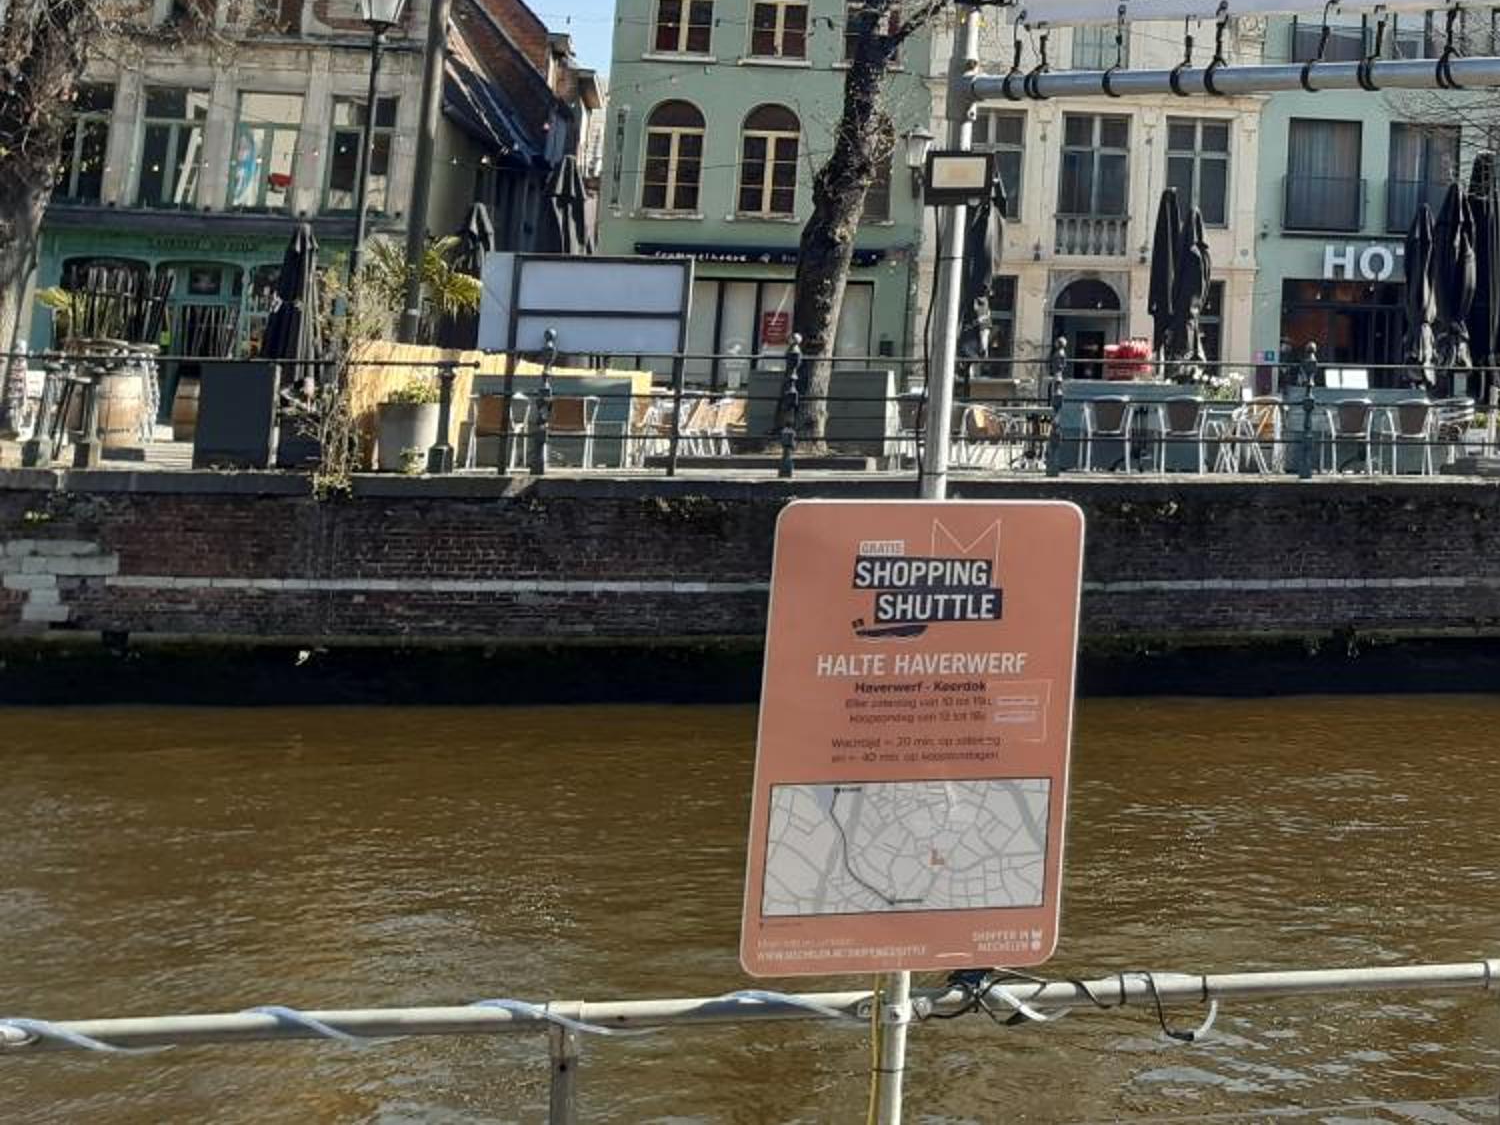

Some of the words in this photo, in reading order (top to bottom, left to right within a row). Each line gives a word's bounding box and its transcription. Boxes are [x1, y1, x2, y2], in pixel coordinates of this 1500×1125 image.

[855, 560, 988, 587] SHOPPING
[877, 594, 995, 620] SHUTTLE
[817, 654, 886, 676] HALTE
[895, 652, 1028, 675] HAVERWERF
[855, 682, 923, 693] Haverwerf
